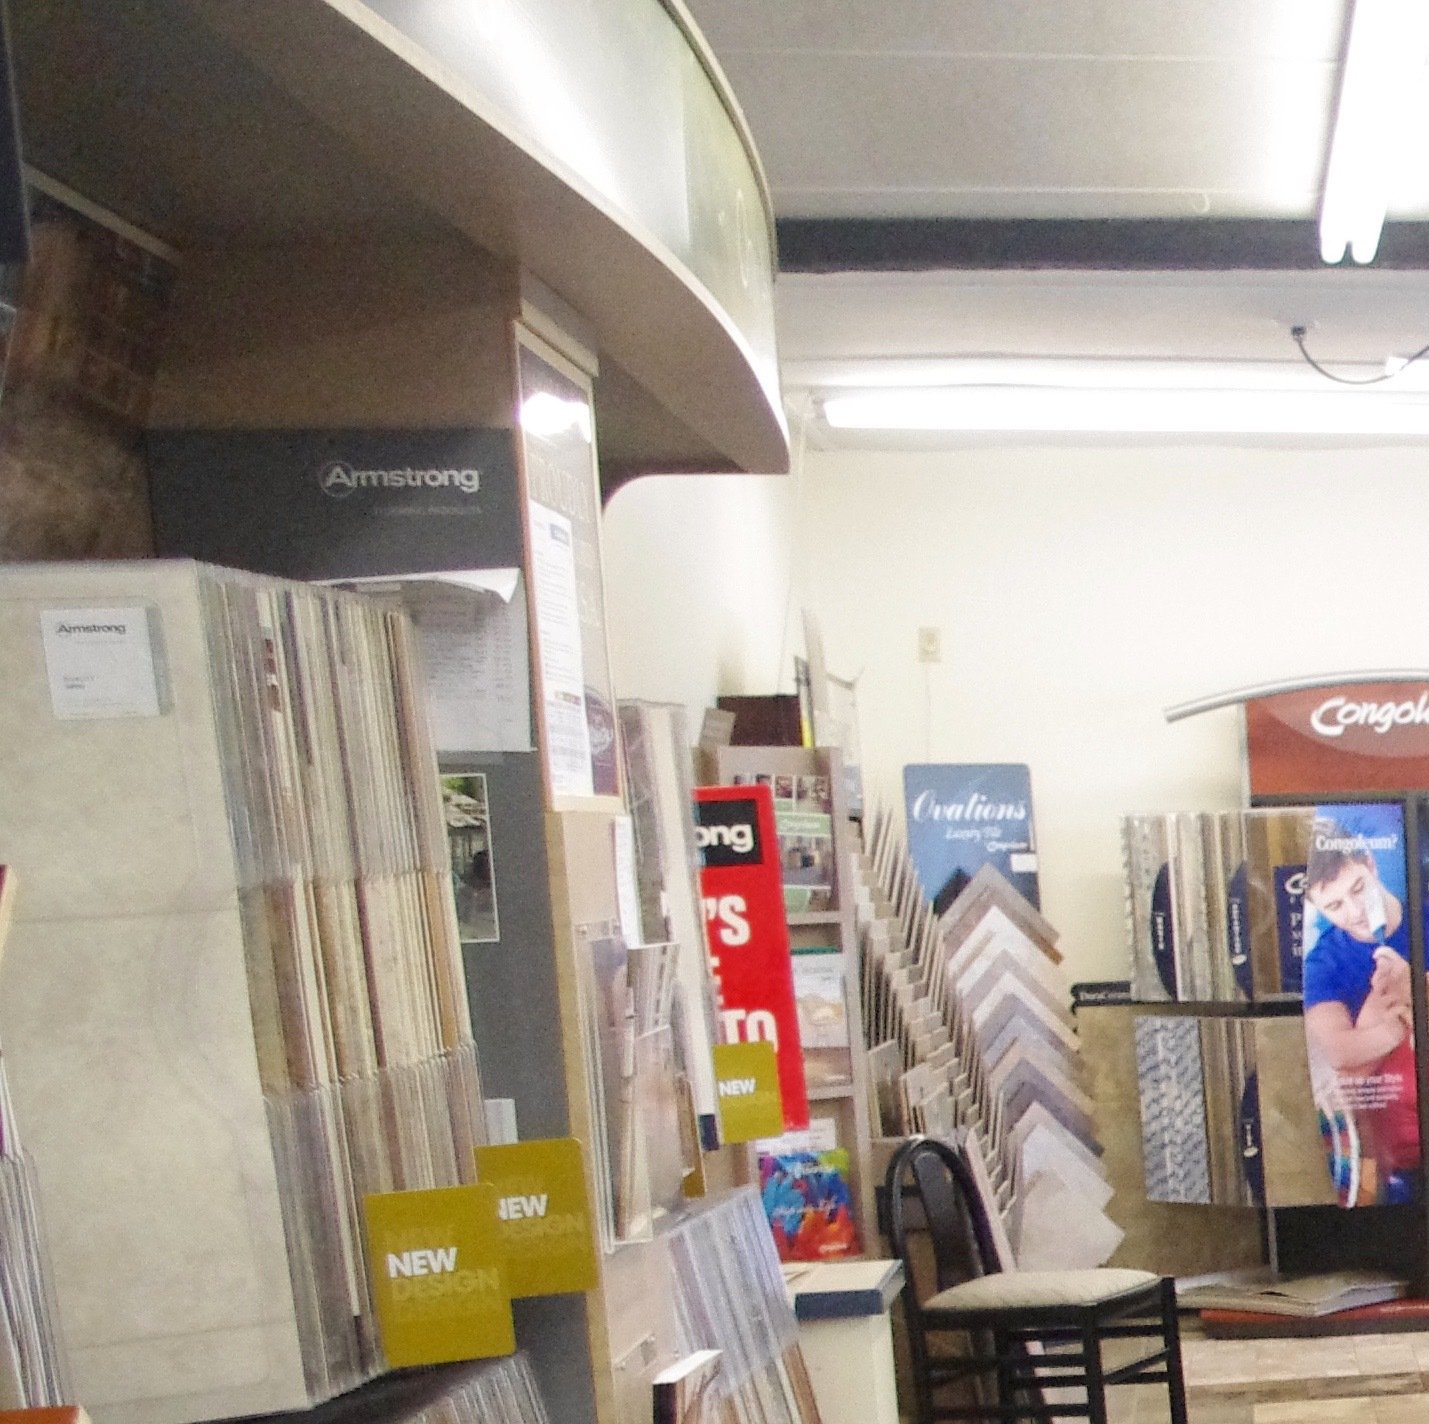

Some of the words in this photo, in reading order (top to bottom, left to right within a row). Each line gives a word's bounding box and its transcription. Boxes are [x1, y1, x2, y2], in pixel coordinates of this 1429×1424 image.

[322, 464, 481, 494] Armstrong
[56, 623, 126, 635] Armstrong
[913, 790, 1026, 822] Ovations
[1315, 833, 1398, 854] Congoleum?
[719, 1078, 756, 1097] NEW
[387, 1247, 457, 1278] NEW
